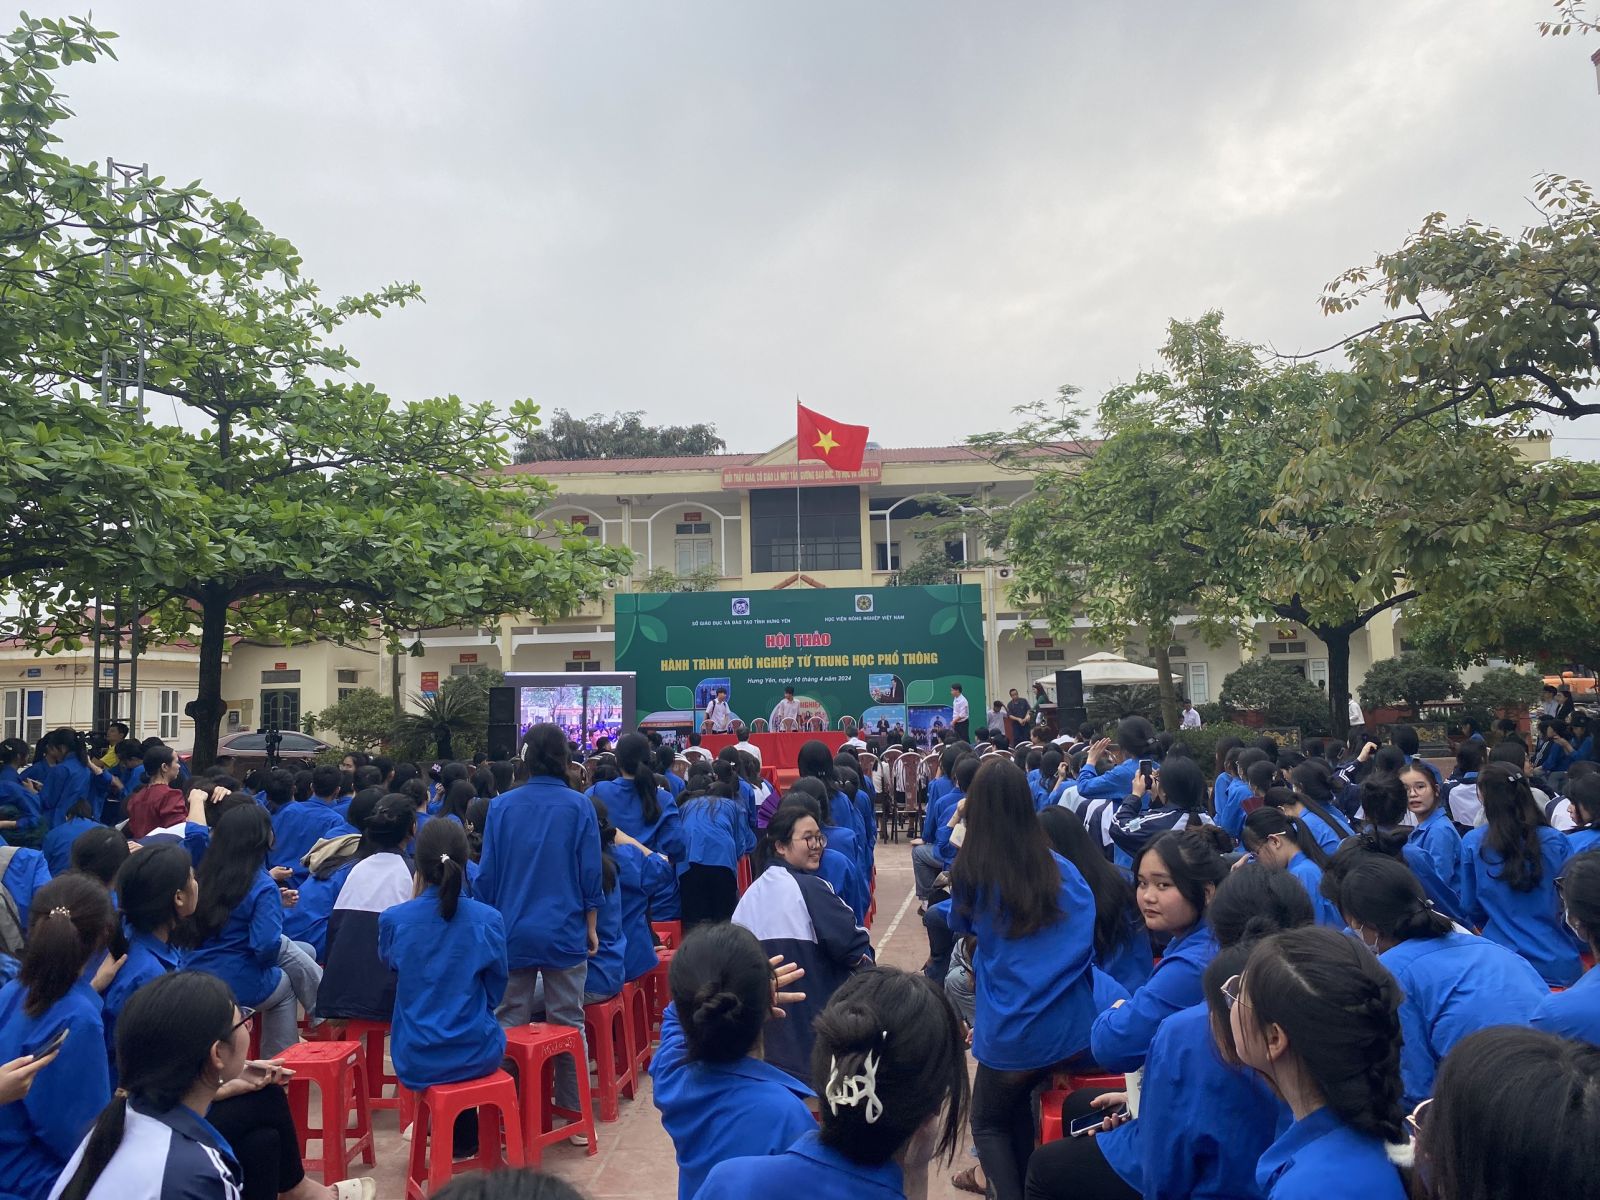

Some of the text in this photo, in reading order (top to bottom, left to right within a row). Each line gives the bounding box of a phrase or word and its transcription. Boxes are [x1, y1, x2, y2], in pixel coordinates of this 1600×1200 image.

[765, 630, 831, 650] HỘI THẢO
[660, 658, 690, 671] HÀNH
[692, 657, 725, 671] TRÌNH
[727, 655, 753, 670] KHỞI
[756, 654, 794, 670] NGHIỆP
[813, 655, 849, 667] TRUNG
[852, 654, 875, 668] HỌC
[877, 649, 900, 665] PHỔ
[902, 651, 938, 665] THÔNG
